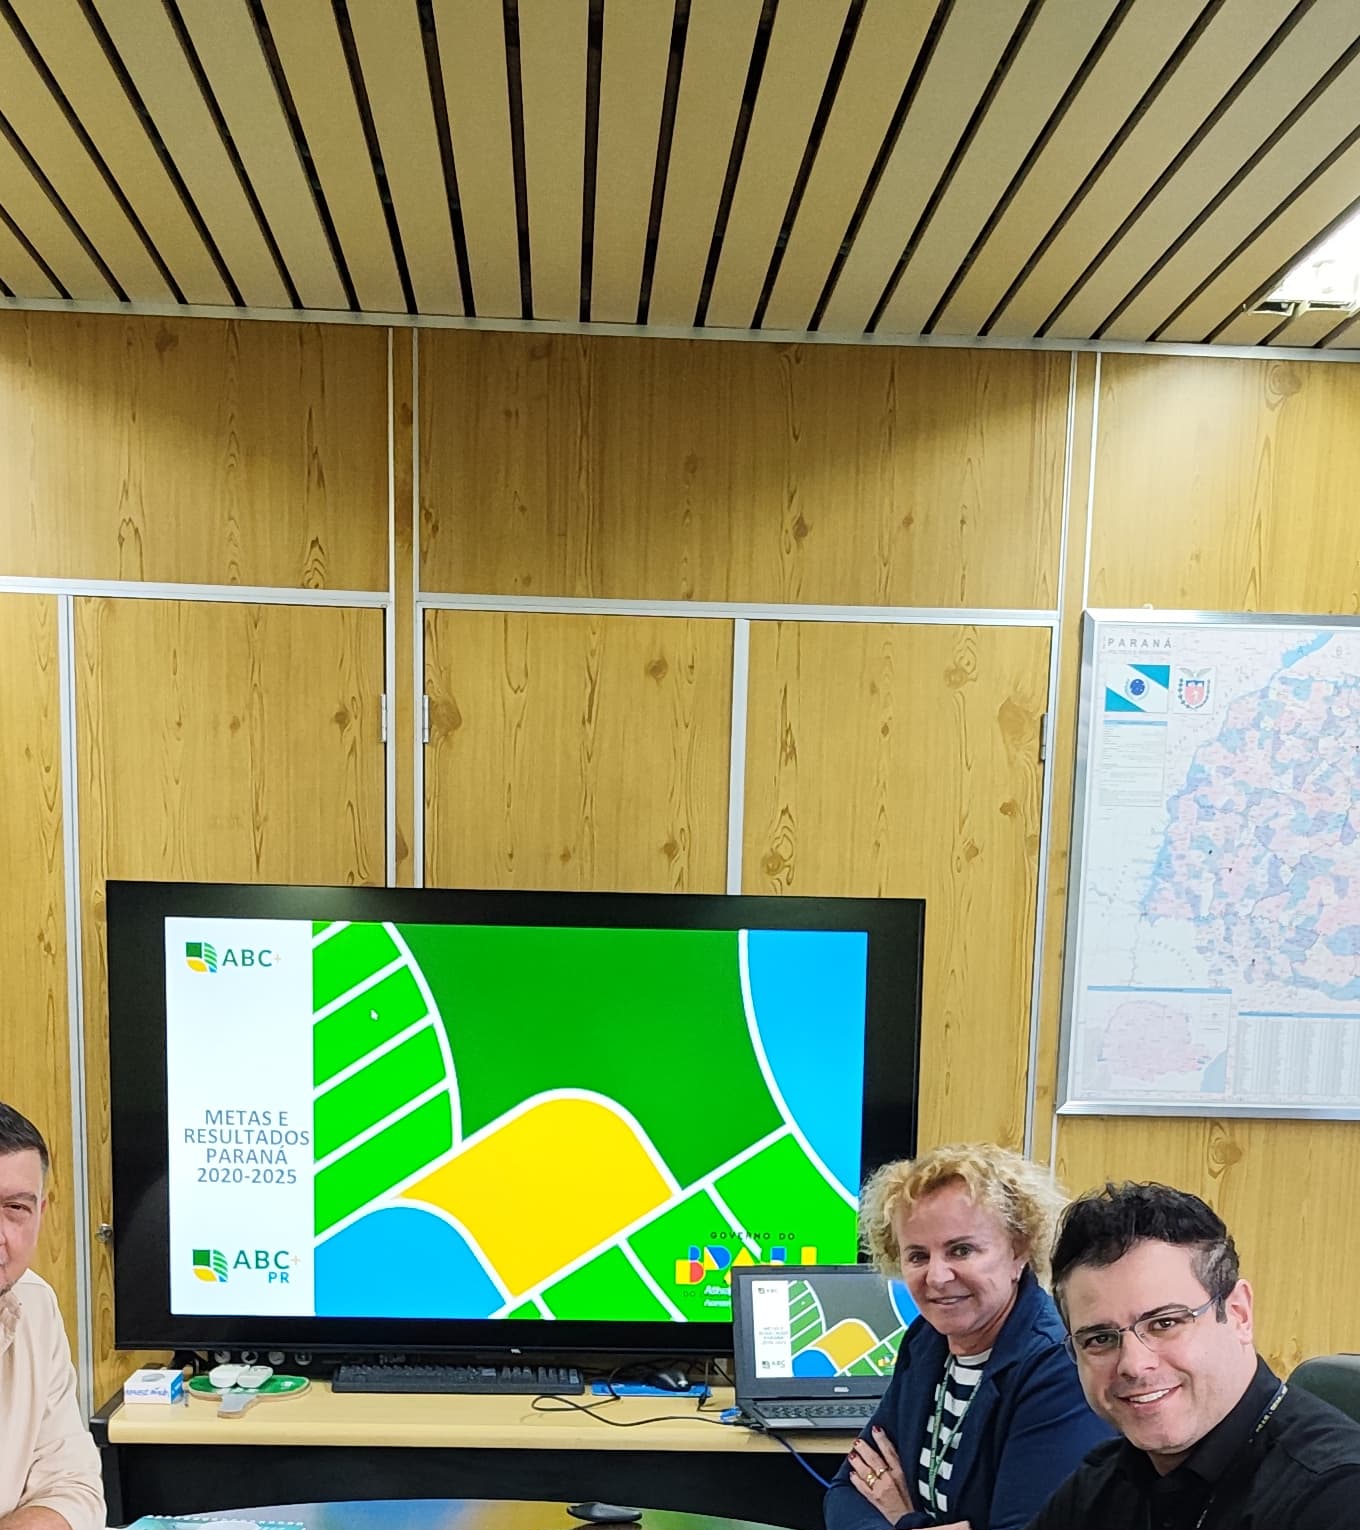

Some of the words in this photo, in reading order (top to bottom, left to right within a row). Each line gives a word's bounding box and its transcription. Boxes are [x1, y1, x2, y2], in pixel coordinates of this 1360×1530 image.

[1107, 637, 1172, 649] PARANÁ
[205, 1109, 272, 1126] METAS
[279, 1111, 289, 1127] E
[184, 1128, 310, 1145] RESULTADOS
[206, 1145, 288, 1165] PARANÁ
[197, 1168, 297, 1184] 2020-2025
[710, 1231, 771, 1240] GOVERNO
[778, 1232, 796, 1240] DO
[268, 1271, 290, 1284] PR
